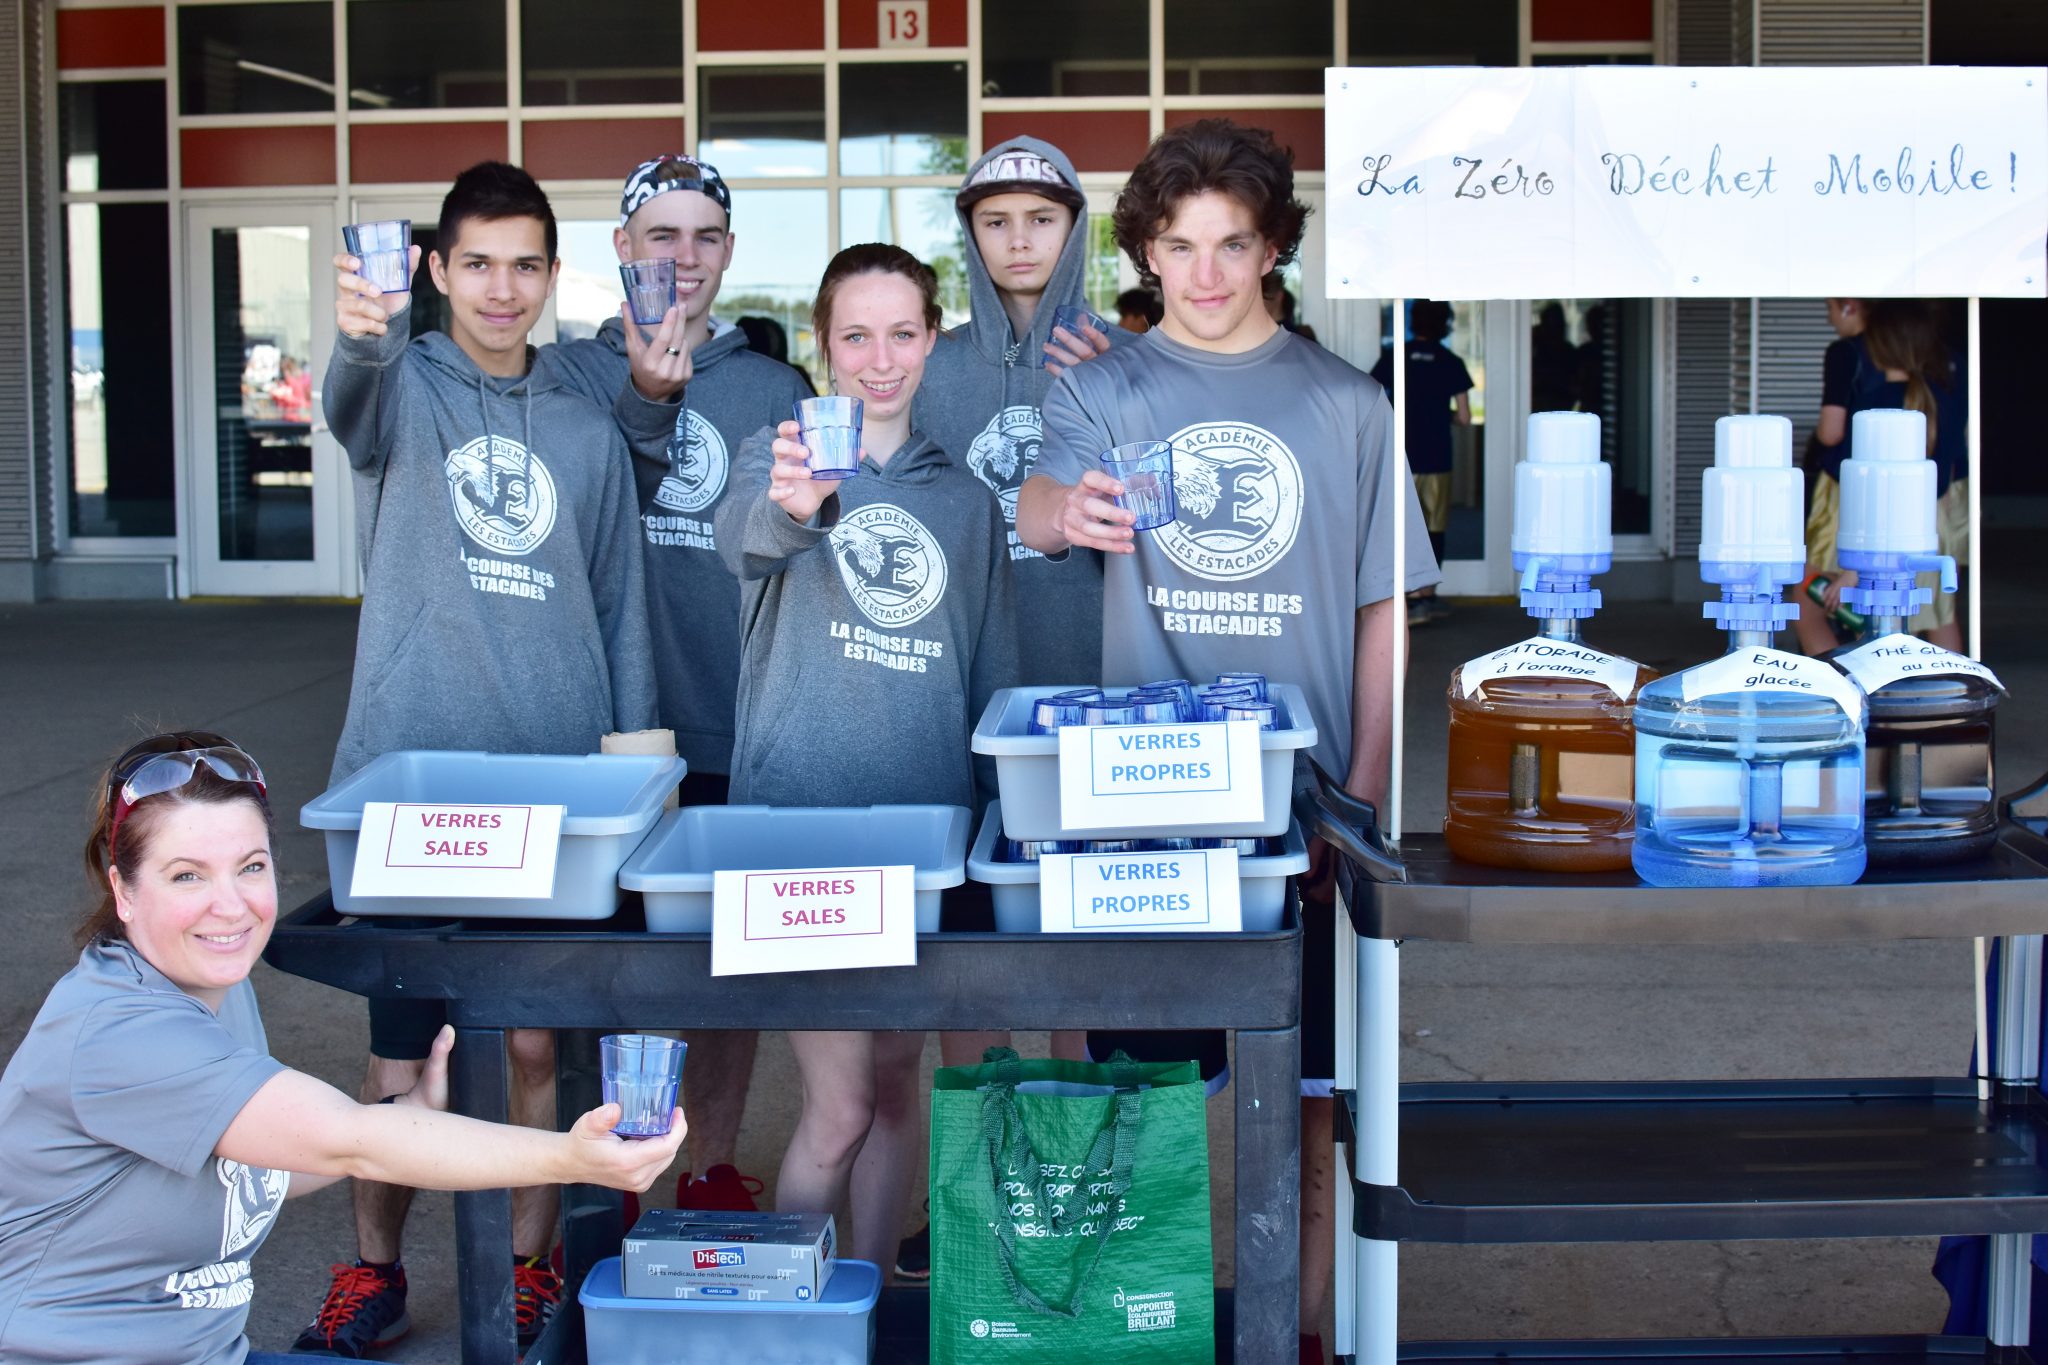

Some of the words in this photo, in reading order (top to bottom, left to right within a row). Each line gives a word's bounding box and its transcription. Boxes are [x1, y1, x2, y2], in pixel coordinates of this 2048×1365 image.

[887, 10, 918, 40] 13
[985, 158, 1061, 182] VANS
[1357, 154, 1424, 196] La
[1453, 156, 1555, 199] Zéro
[1601, 143, 1778, 199] Déchet
[1186, 429, 1273, 455] ACADÉMIE
[646, 516, 701, 534] COURSE
[1169, 536, 1194, 559] LES
[1197, 538, 1280, 570] ESTACADES
[467, 557, 531, 580] COURSE
[470, 574, 546, 601] STACADES
[852, 586, 867, 605] LES
[869, 596, 928, 620] ESTACADES
[1147, 585, 1169, 607] LA
[1172, 589, 1258, 613] COURSE
[1264, 593, 1303, 615] DES
[1163, 612, 1283, 637] ESTACADES
[830, 620, 850, 639] LA
[854, 625, 911, 653] COURSE
[914, 638, 943, 658] DES
[844, 642, 927, 673] ESTACADES
[1492, 643, 1612, 665] GATORADE
[1870, 644, 1912, 658] THÉ
[1496, 662, 1508, 674] à
[1517, 661, 1596, 676] l'orange
[1752, 654, 1798, 672] EAU
[1901, 661, 1922, 672] au
[1930, 661, 1982, 673] citron
[1744, 673, 1812, 688] glacée
[1118, 732, 1201, 751] VERRES
[1111, 762, 1211, 782] PROPRES
[420, 813, 502, 829] VERRES
[424, 839, 489, 857] SALES
[1098, 862, 1180, 881] VERRES
[773, 879, 855, 898] VERRES
[1091, 893, 1190, 914] PROPRES
[781, 908, 846, 927] SALES
[697, 1249, 742, 1265] DisTech
[798, 1289, 808, 1298] M
[1127, 1300, 1175, 1313] RAPPORTER
[1128, 1315, 1176, 1328] BRILLANT
